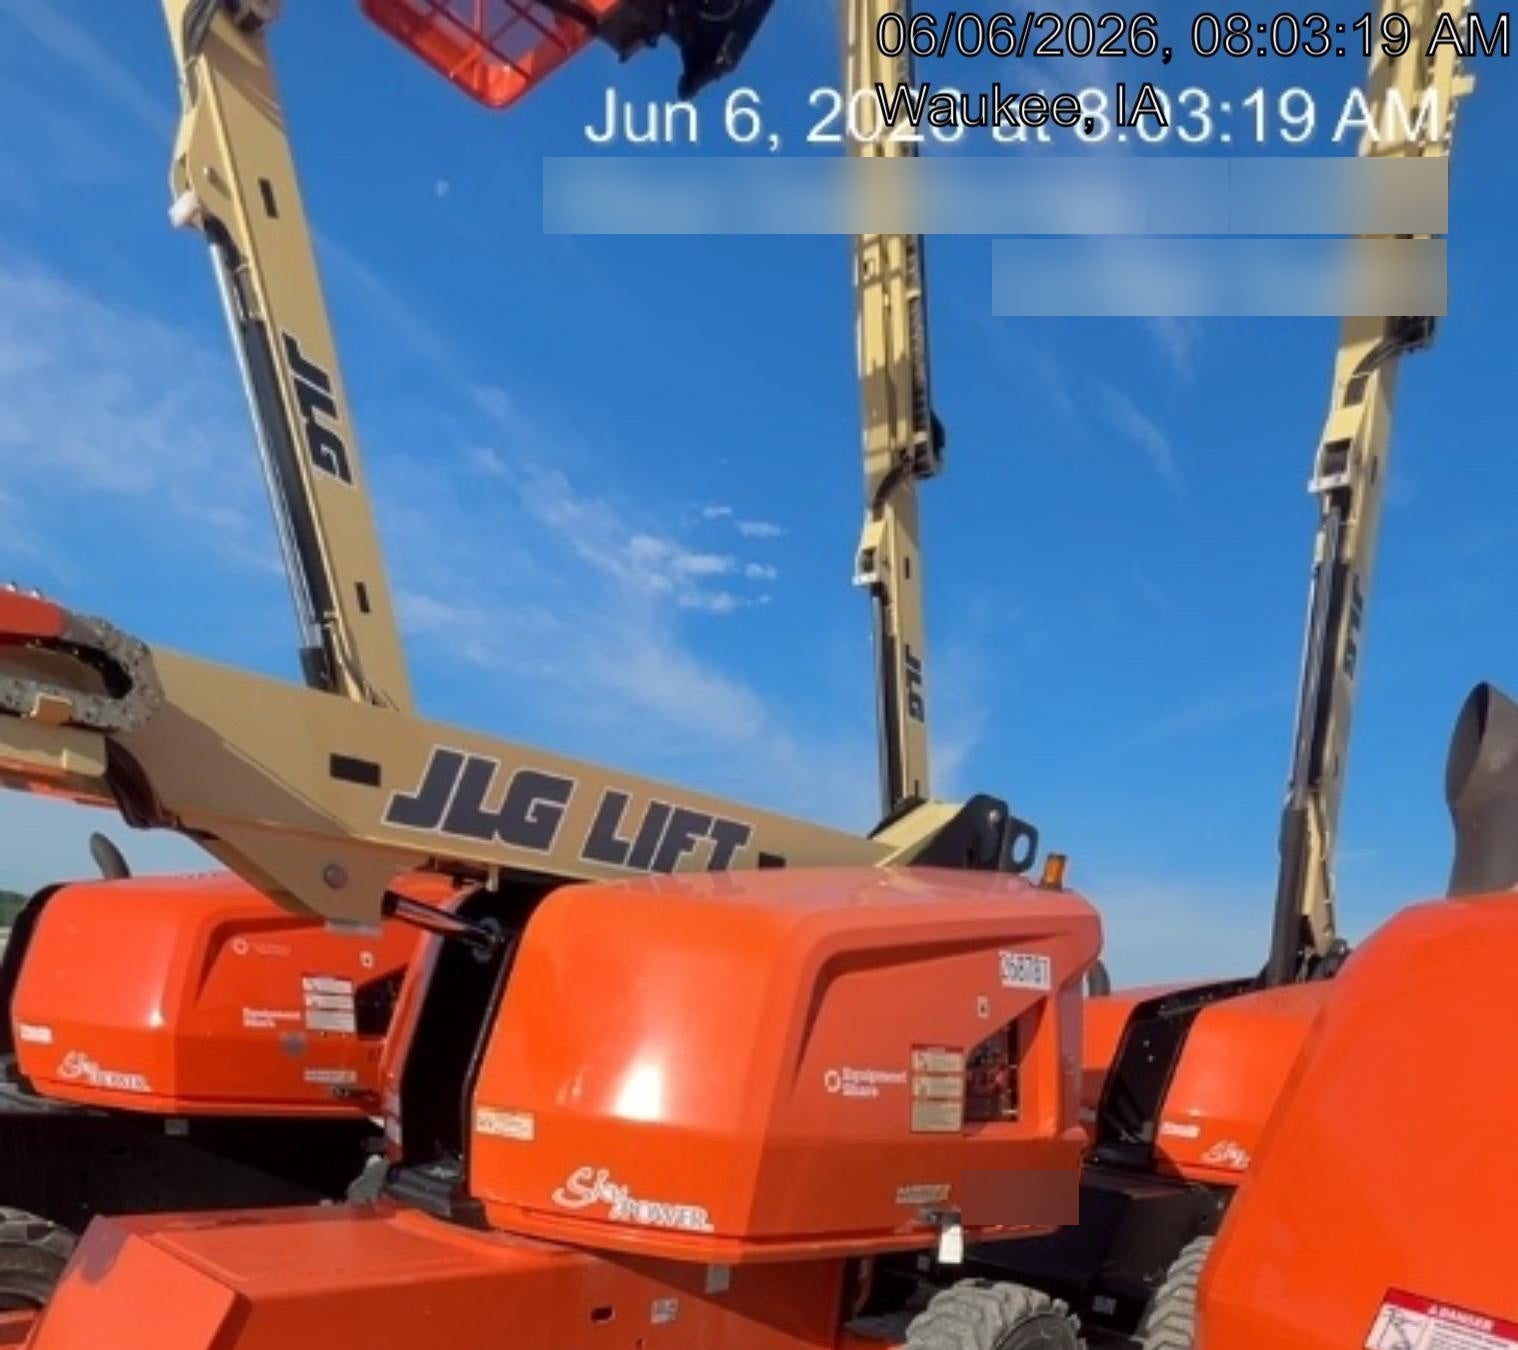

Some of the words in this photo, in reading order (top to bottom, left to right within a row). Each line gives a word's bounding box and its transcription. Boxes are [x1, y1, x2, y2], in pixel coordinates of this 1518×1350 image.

[280, 331, 354, 488] JLG
[904, 644, 926, 724] JLG
[382, 744, 579, 856] JLG
[579, 786, 756, 873] LIFT
[1439, 1305, 1495, 1332] DANGER
